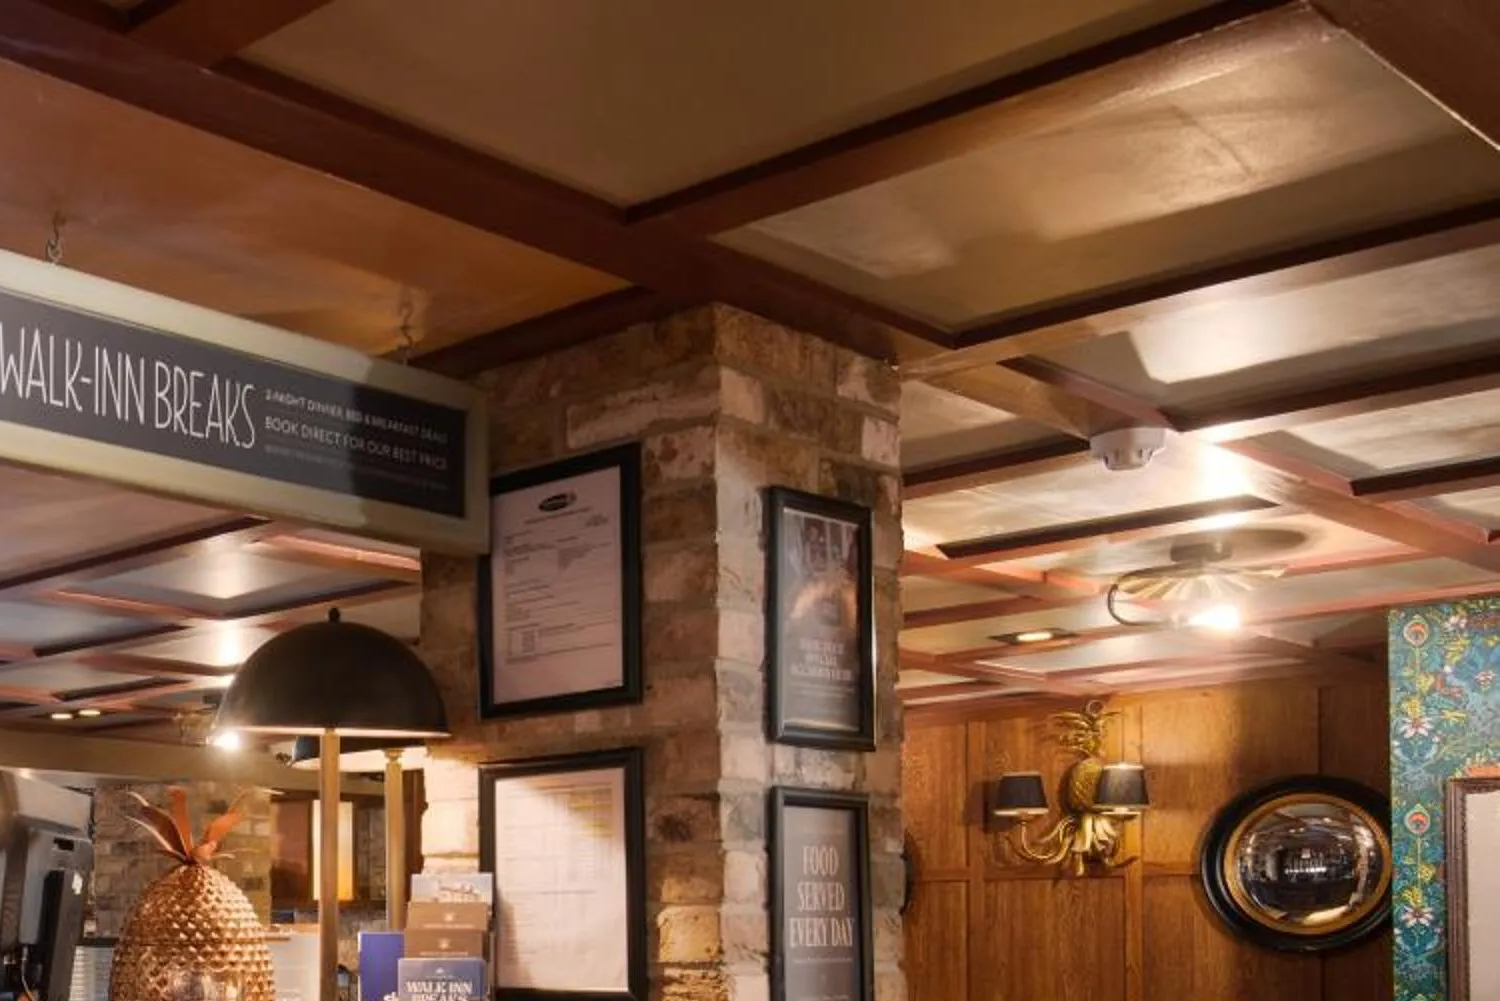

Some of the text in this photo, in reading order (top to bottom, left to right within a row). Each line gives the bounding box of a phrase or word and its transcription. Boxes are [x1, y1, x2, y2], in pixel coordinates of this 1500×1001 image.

[154, 360, 257, 450] BREAKS
[264, 415, 300, 437] BOOK
[301, 423, 343, 448] DIRECT
[343, 433, 365, 452] FOR
[366, 440, 391, 460] OUR
[802, 845, 839, 876] FOOD
[797, 881, 845, 912] SERVED
[789, 917, 855, 949] EVERY DAY
[404, 981, 473, 995] WALK INN
